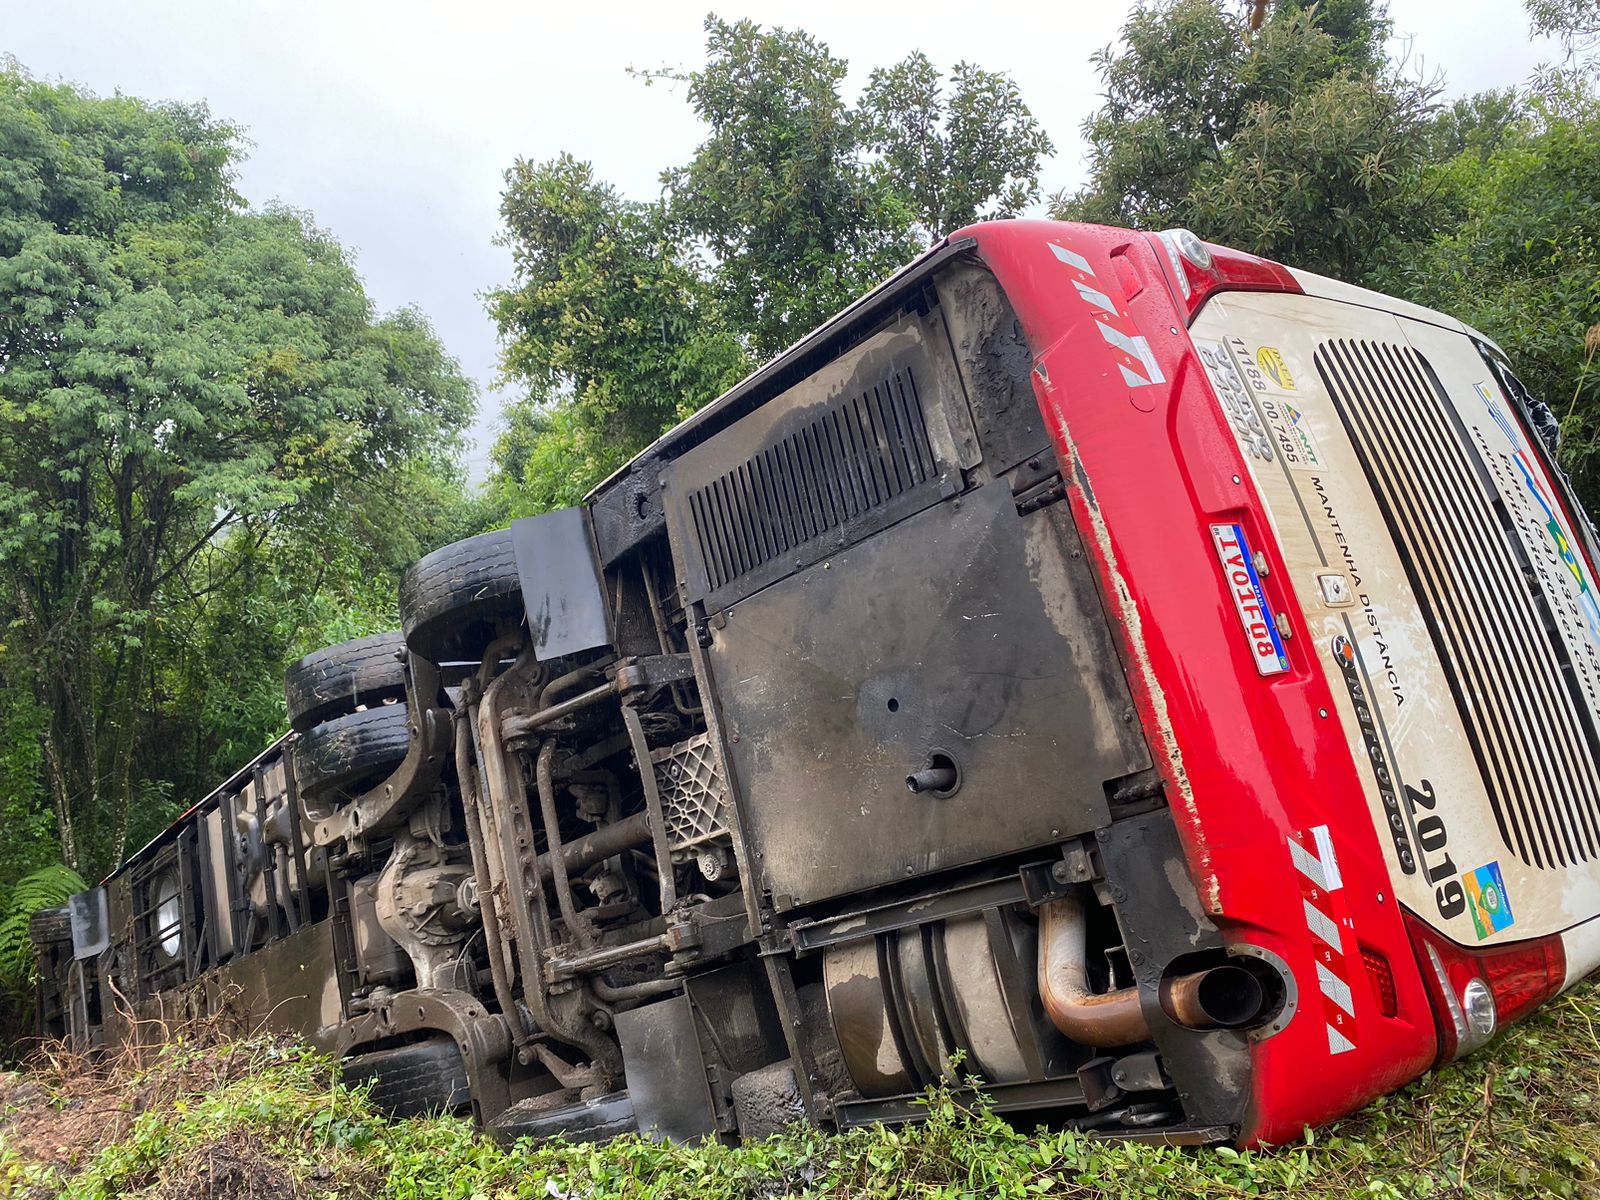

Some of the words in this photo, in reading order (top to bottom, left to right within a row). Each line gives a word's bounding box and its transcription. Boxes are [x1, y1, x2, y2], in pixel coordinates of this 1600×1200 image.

[1214, 344, 1274, 462] VOLVO
[1232, 337, 1267, 391] 11188
[1262, 401, 1300, 463] 00.7495
[1295, 425, 1319, 466] ANTT
[1311, 476, 1362, 588] MANTENHA
[1498, 451, 1532, 512] Fone:
[1530, 517, 1558, 566] (54)
[1253, 584, 1265, 608] BRASIL
[1358, 593, 1405, 708] DISTÂNCIA
[1347, 675, 1414, 869] Marcopolo
[1404, 778, 1467, 921] 2019
